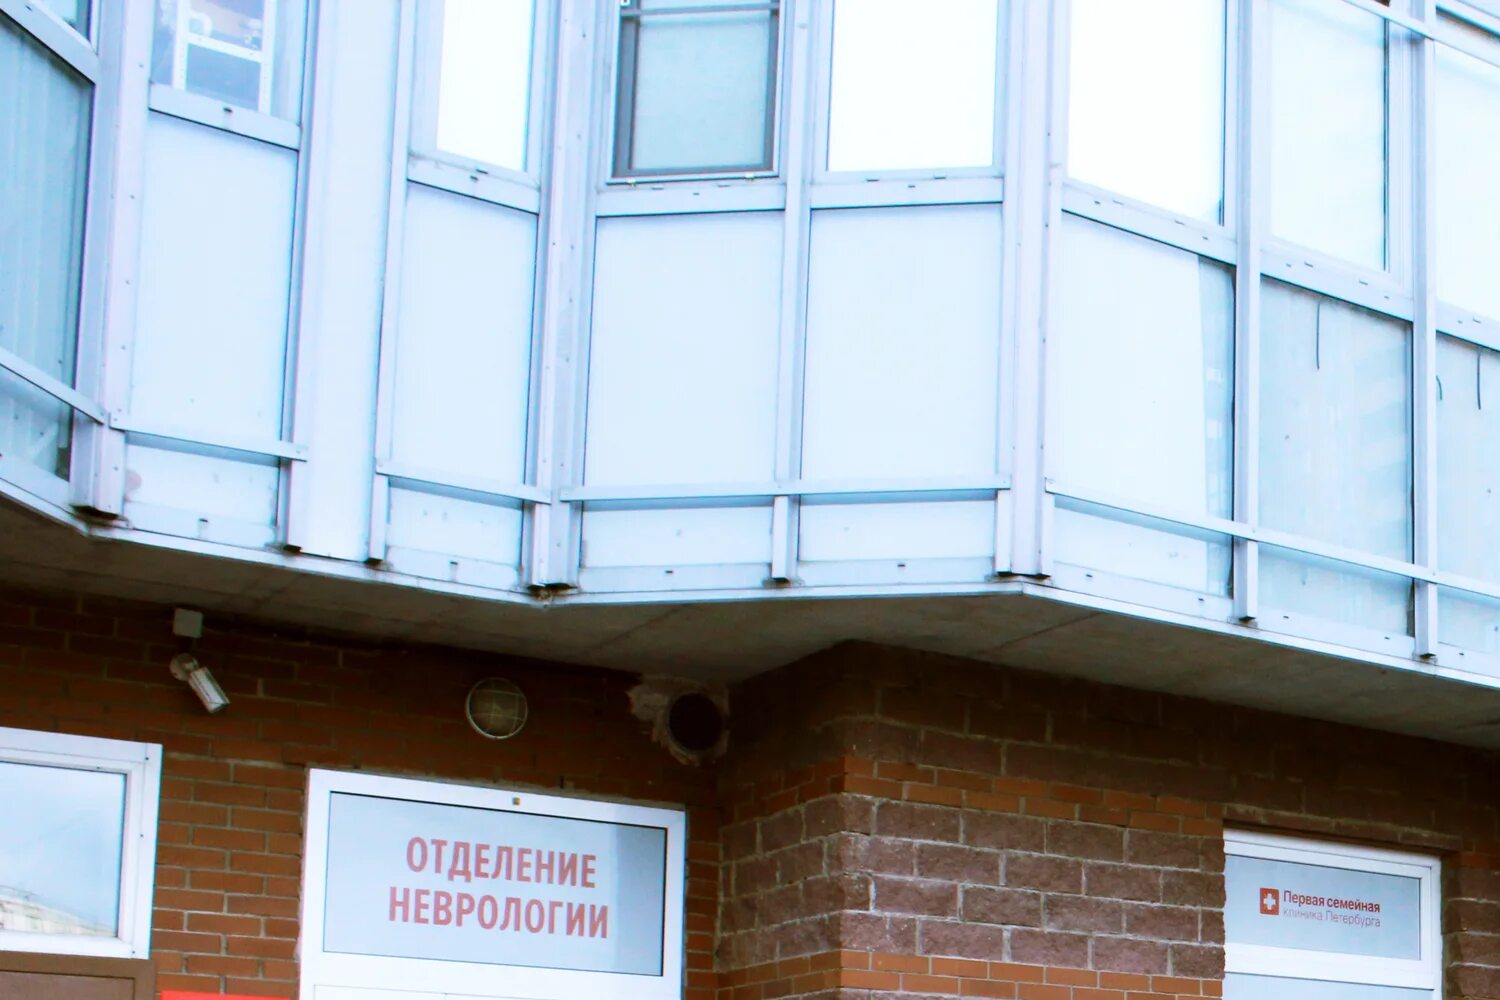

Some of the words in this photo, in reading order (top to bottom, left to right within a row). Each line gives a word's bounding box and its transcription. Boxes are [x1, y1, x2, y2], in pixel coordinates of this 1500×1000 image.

[406, 836, 597, 889] ОТДЕЛЕНИЕ
[388, 886, 609, 939] НЕВРОЛОГИИ
[1283, 890, 1325, 908] Первая
[1326, 897, 1381, 913] семейная
[1283, 908, 1322, 921] клиника
[1325, 910, 1381, 928] Петербурга
